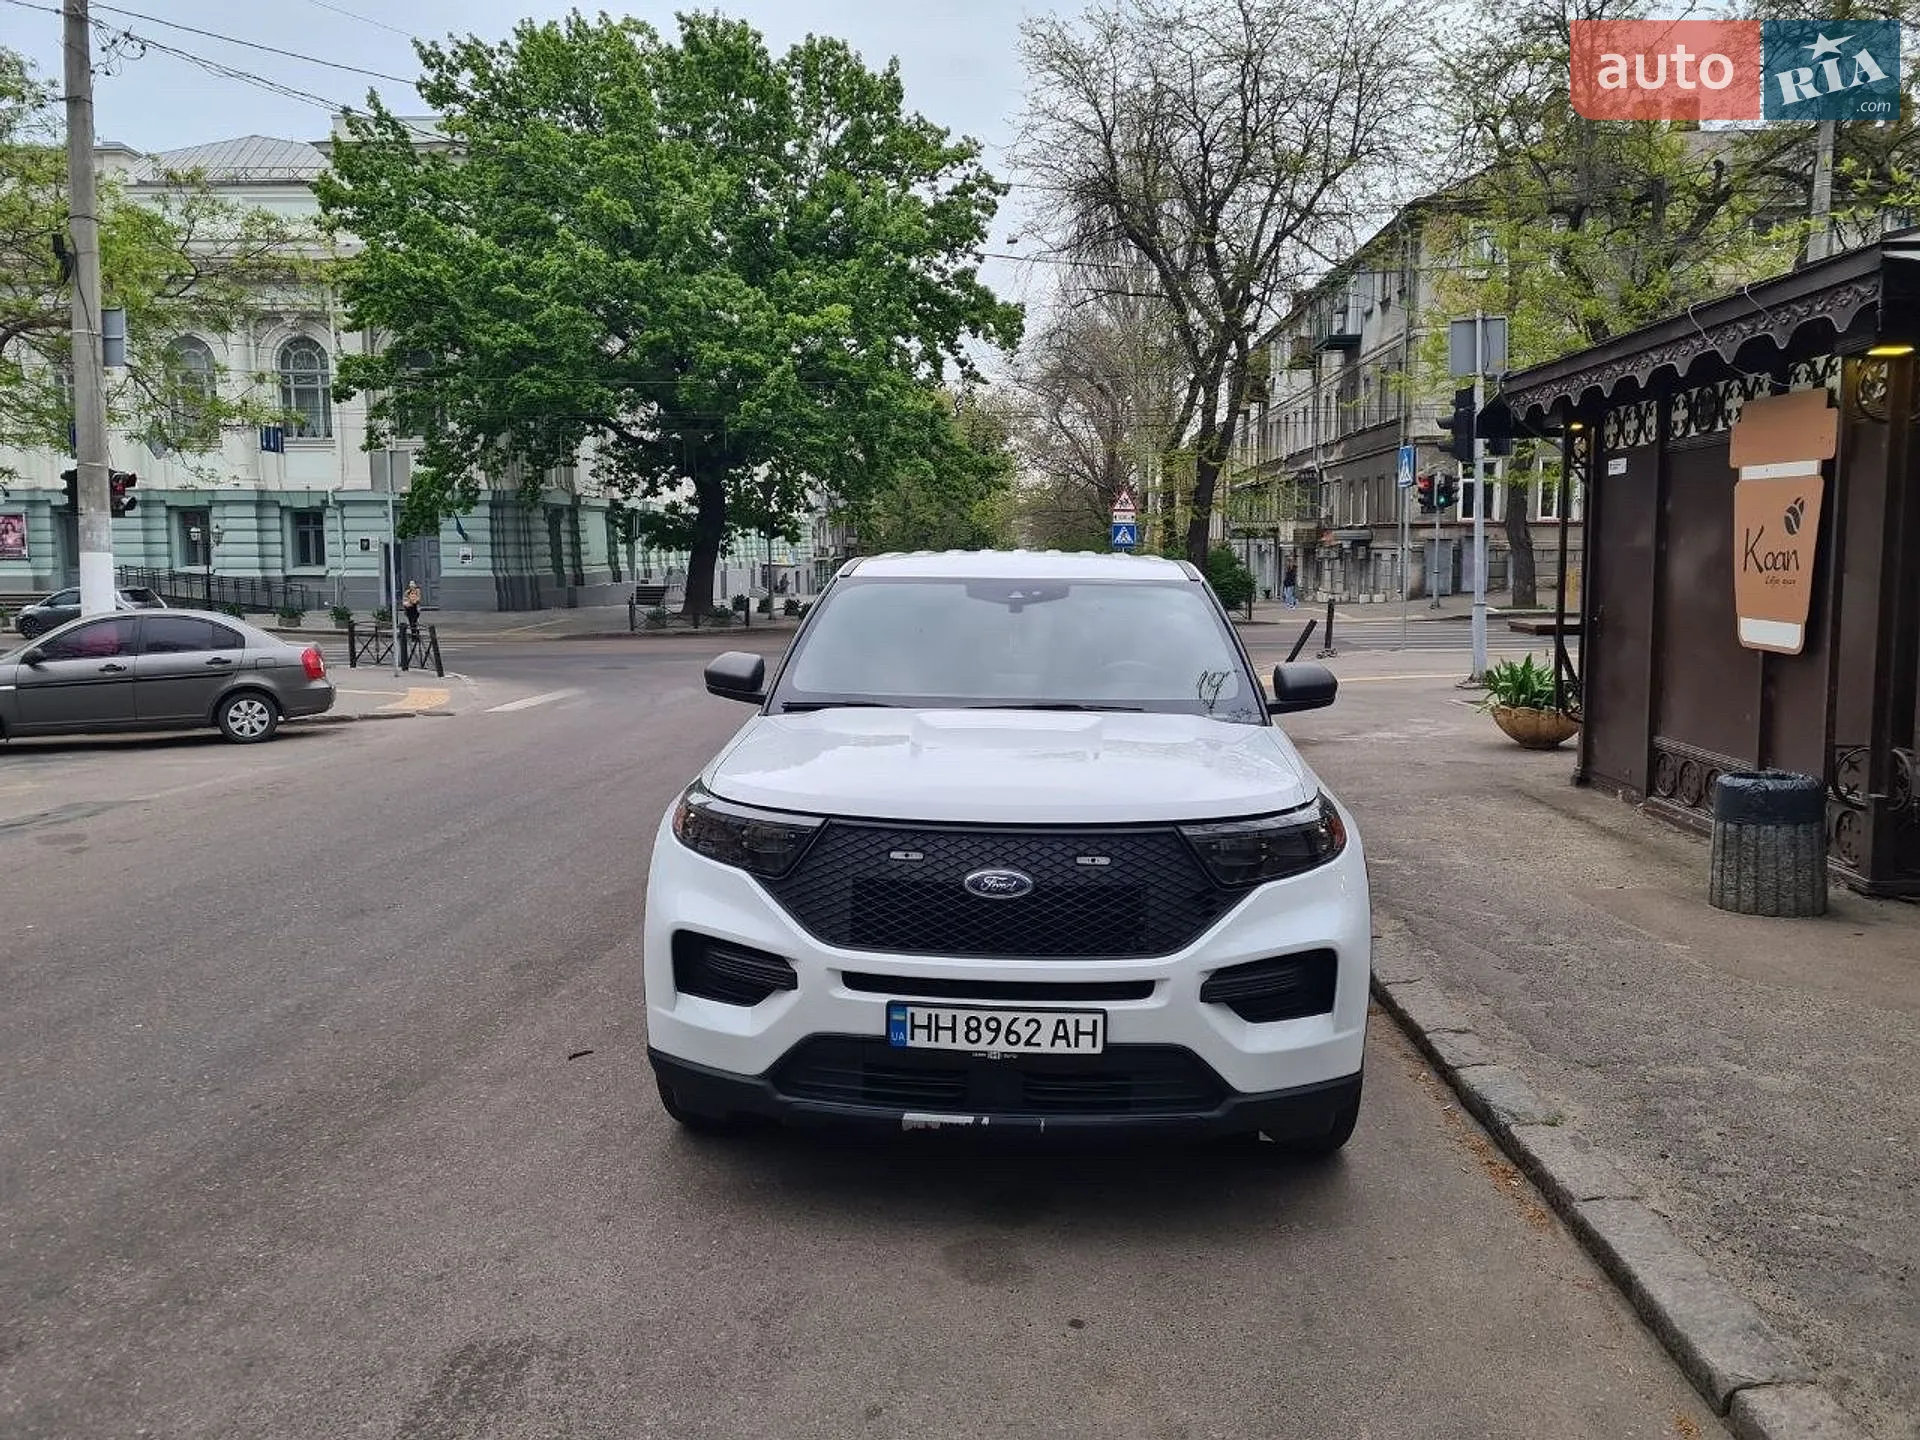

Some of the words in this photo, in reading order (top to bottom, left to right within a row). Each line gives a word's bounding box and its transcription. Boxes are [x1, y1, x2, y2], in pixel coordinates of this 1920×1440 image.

[981, 876, 1017, 891] Ford
[891, 1031, 905, 1042] UA
[910, 1012, 956, 1043] HH
[964, 1015, 1042, 1047] 8962
[1050, 1018, 1098, 1048] AH
